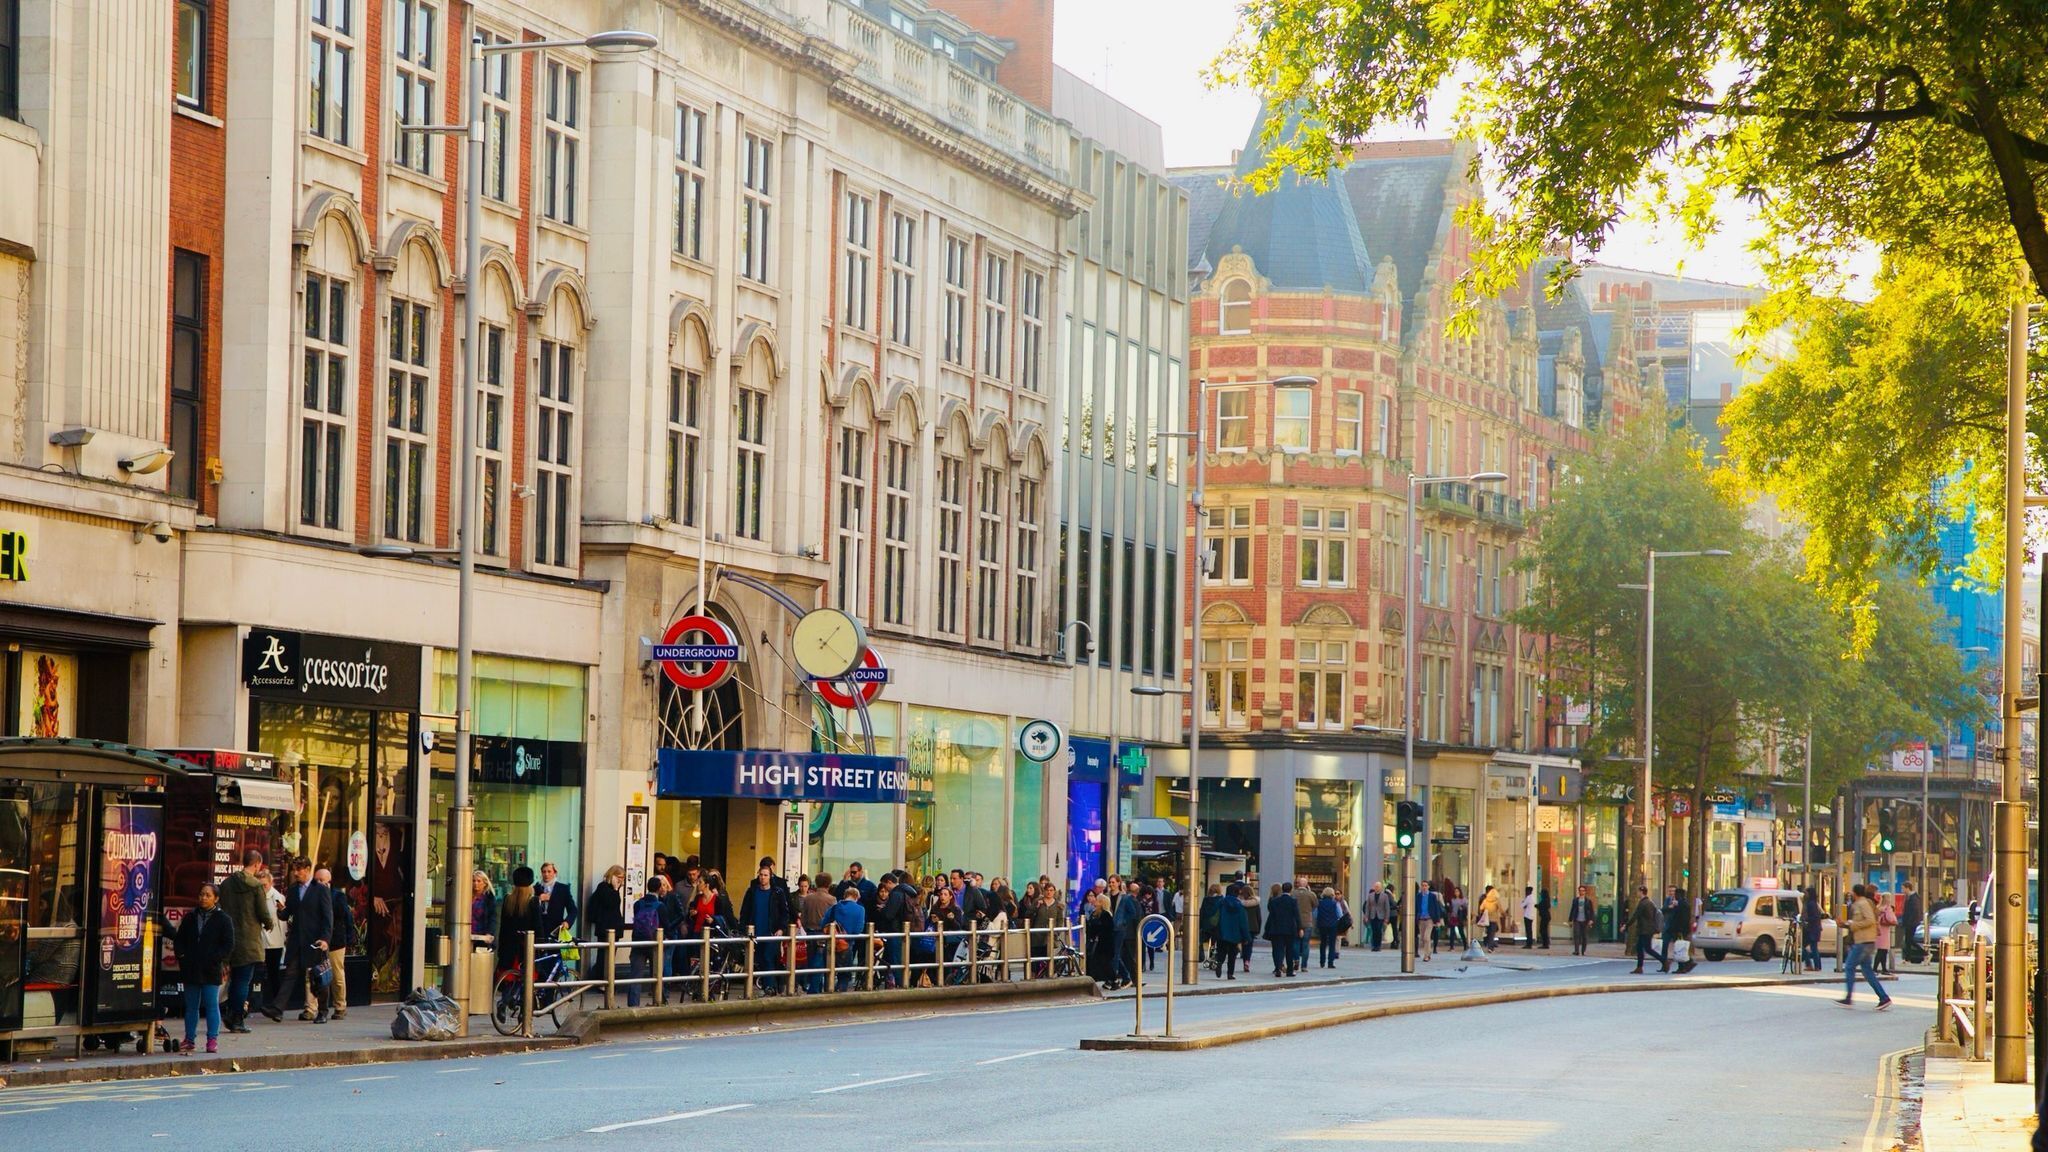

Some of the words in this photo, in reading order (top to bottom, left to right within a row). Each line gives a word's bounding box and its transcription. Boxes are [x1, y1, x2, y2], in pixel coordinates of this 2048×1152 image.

[258, 635, 289, 673] A
[656, 648, 735, 658] UNDERGROUND
[302, 648, 388, 694] ccessorize
[251, 675, 295, 686] Accessorize
[215, 752, 241, 769] EVENT
[515, 744, 525, 777] 3
[525, 753, 541, 770] Store
[739, 765, 799, 785] HIGH
[807, 766, 875, 789] STREET
[216, 829, 225, 838] FILM
[226, 829, 230, 838] &
[230, 829, 236, 838] TV
[107, 831, 156, 861] CUBANISTO
[215, 840, 235, 850] CELEBRITY
[215, 852, 230, 862] BOOKS
[214, 864, 228, 874] MUSIC
[228, 864, 232, 874] &
[119, 915, 138, 925] RUM
[118, 930, 137, 939] BEER
